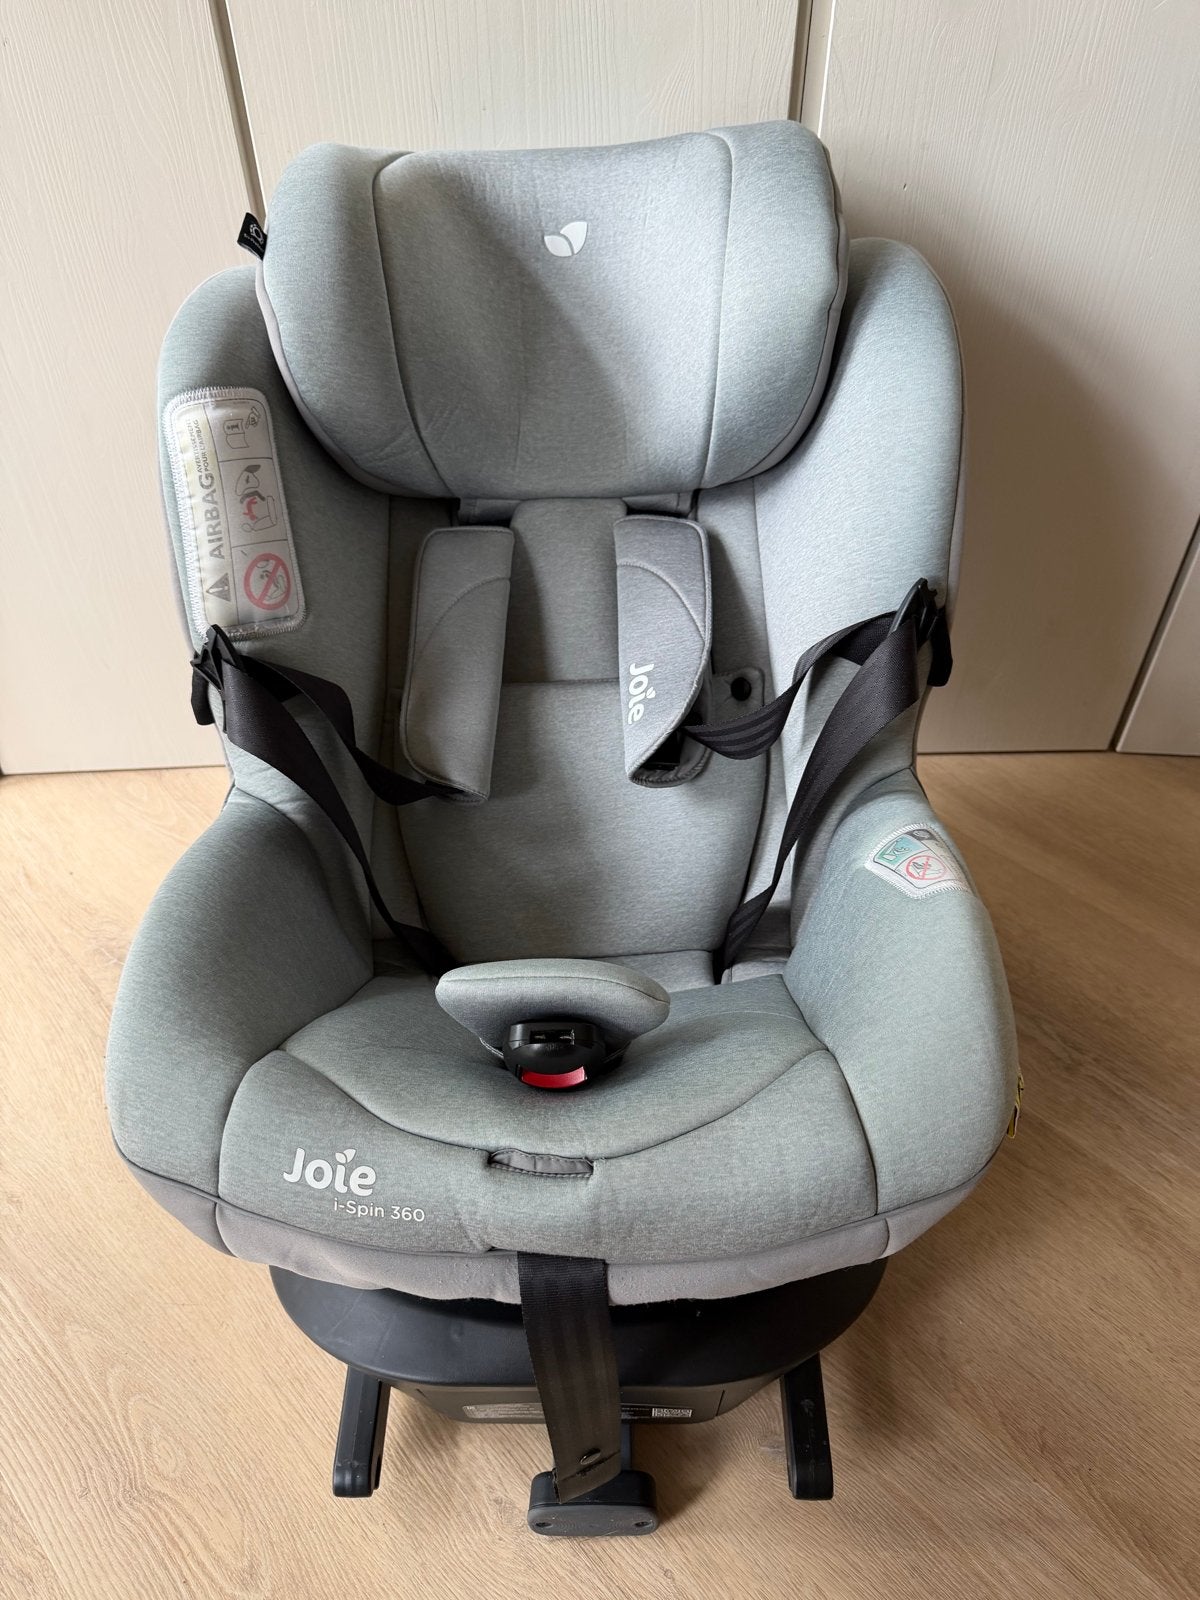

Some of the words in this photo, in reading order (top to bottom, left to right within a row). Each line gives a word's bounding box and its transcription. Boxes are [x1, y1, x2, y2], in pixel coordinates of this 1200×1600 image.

[201, 451, 210, 472] POUR
[199, 473, 225, 560] AIRBAG
[628, 663, 656, 725] Joie
[283, 1147, 377, 1197] Joie
[333, 1197, 385, 1218] i-Spin
[390, 1205, 425, 1222] 360
